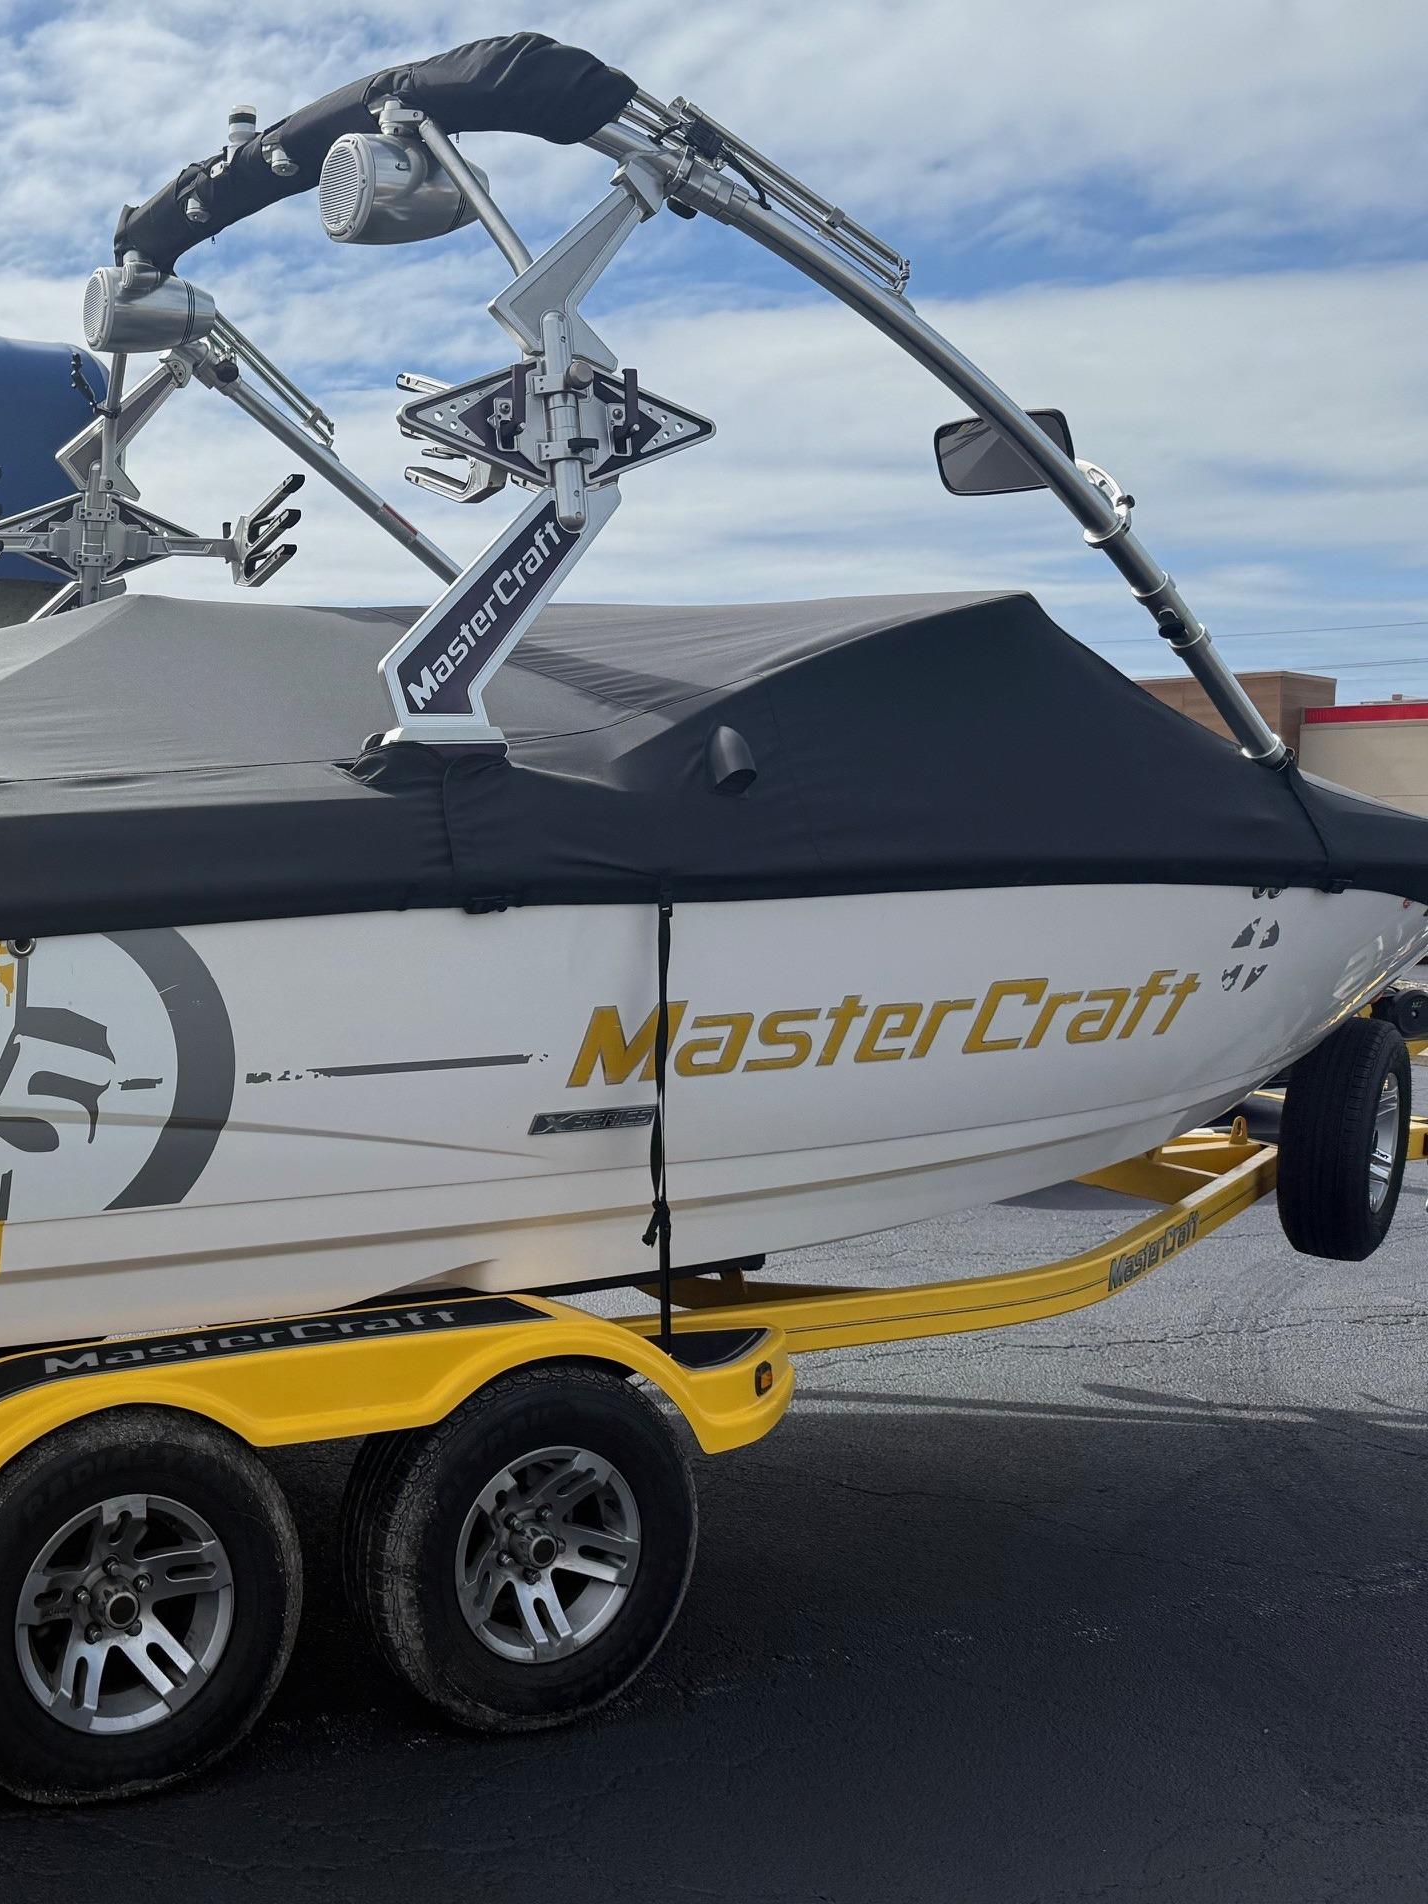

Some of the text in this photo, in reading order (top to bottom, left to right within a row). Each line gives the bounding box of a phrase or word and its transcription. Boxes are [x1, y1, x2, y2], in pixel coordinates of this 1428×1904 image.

[407, 519, 564, 712] MasterCraft
[565, 968, 1200, 1089] MasterCraft
[1107, 1209, 1200, 1292] MasterCraft
[44, 1309, 458, 1375] MasterCraft
